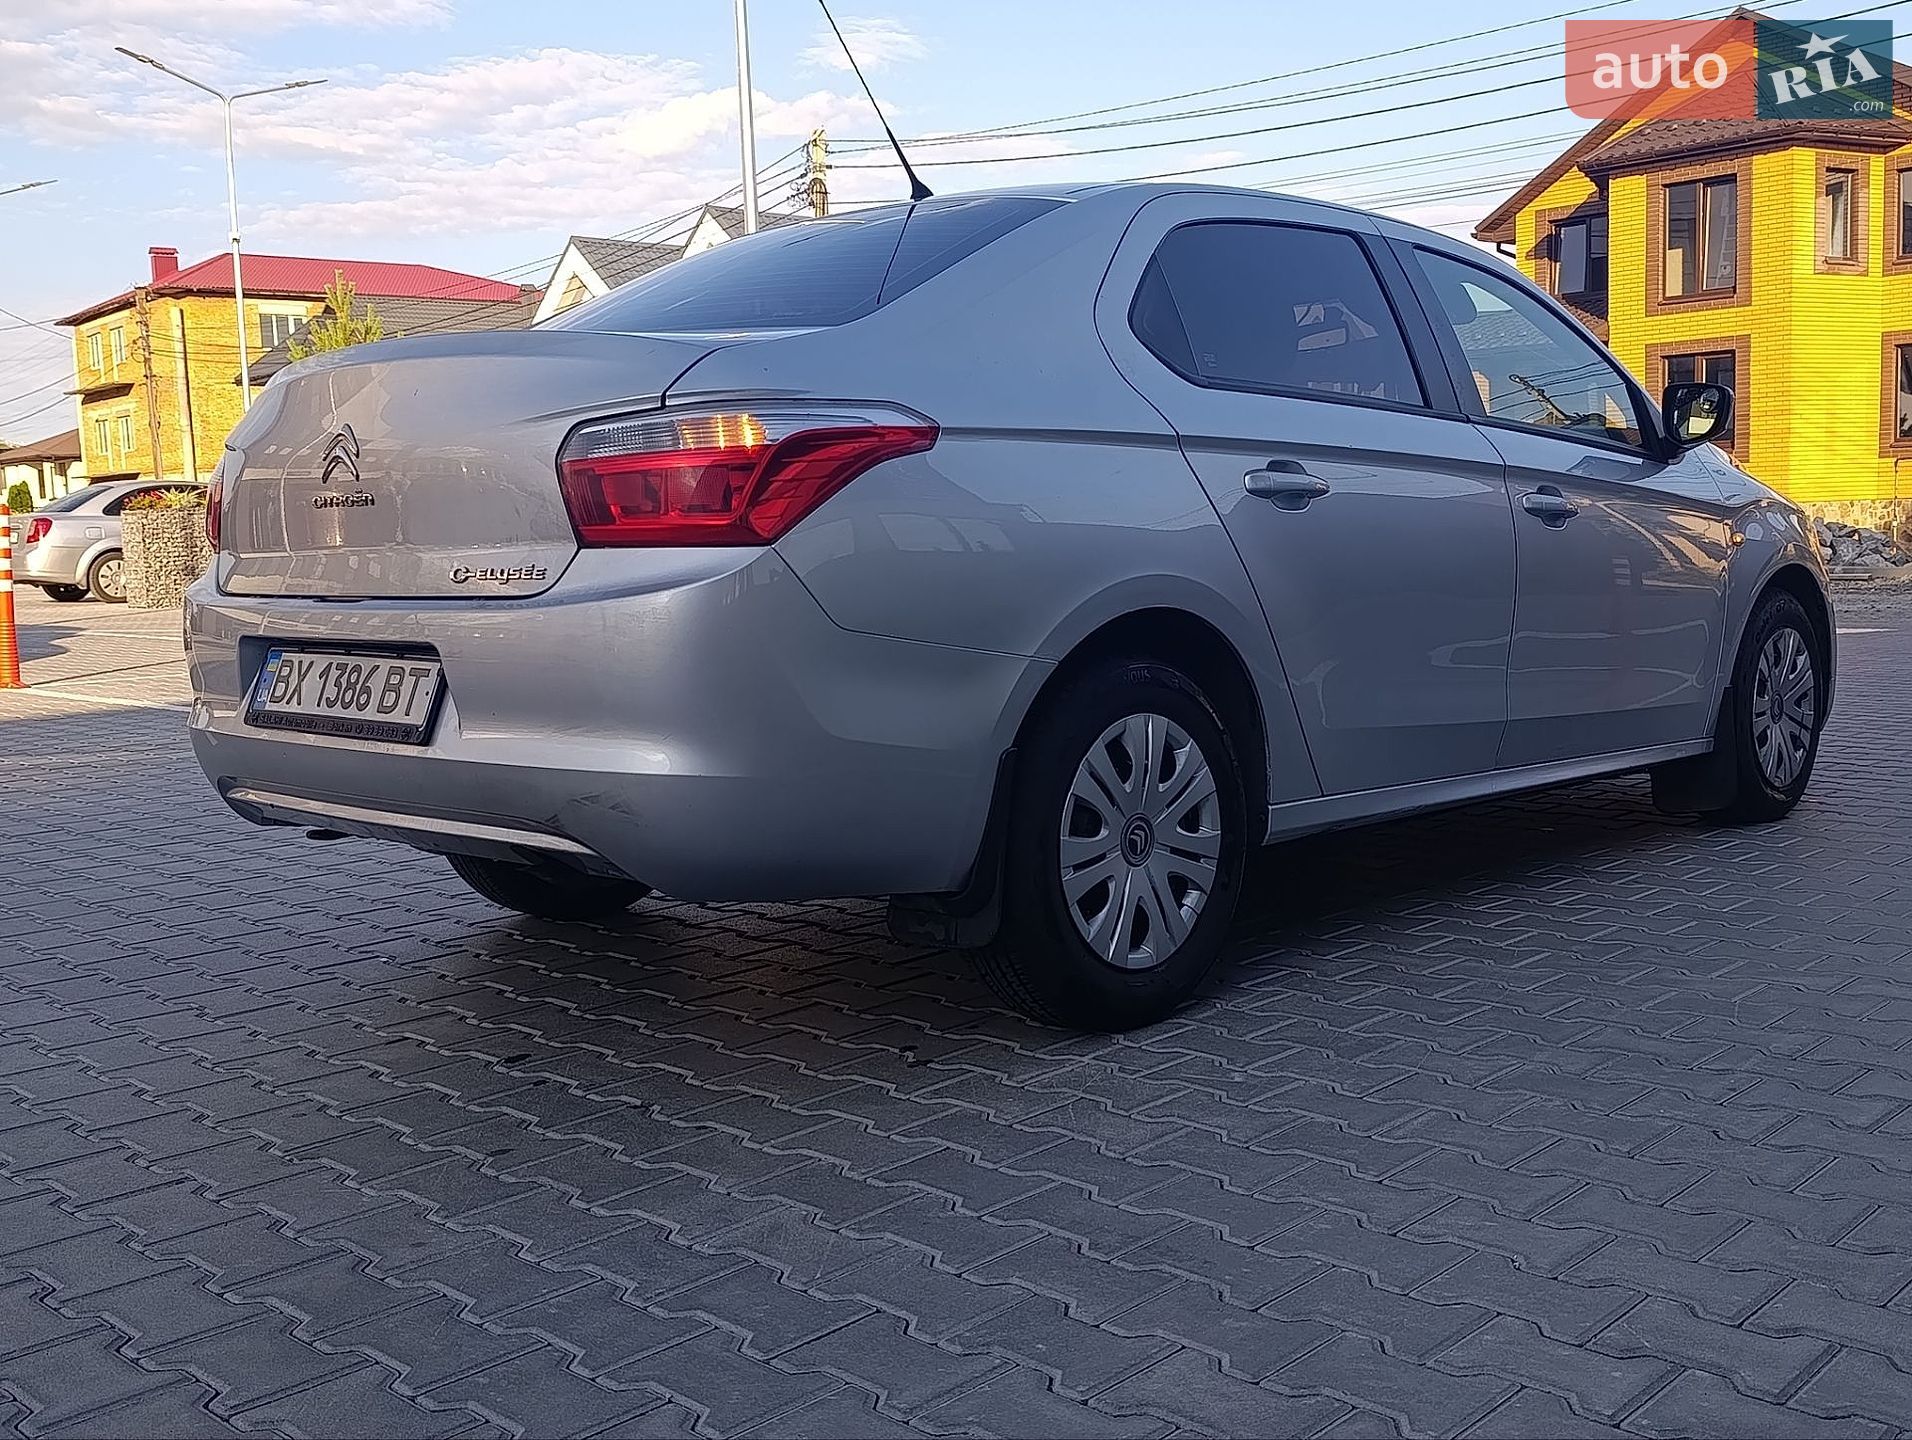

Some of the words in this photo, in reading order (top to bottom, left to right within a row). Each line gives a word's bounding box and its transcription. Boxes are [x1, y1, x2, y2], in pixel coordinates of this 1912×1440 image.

[269, 659, 314, 706] BX
[317, 661, 381, 712] 1386
[376, 666, 432, 717] BT
